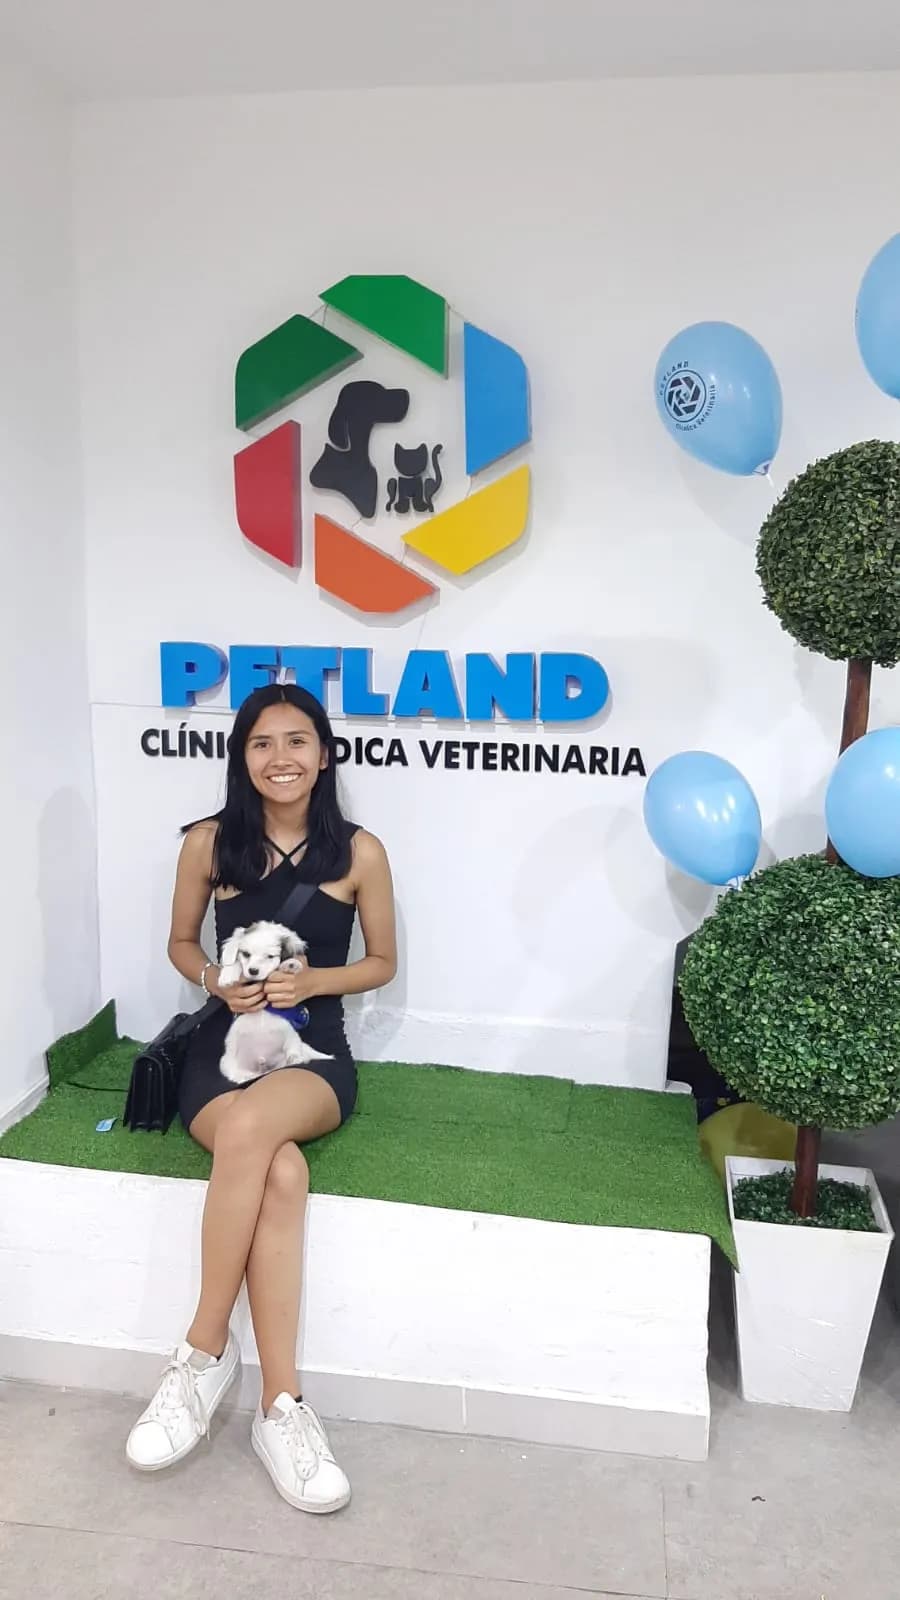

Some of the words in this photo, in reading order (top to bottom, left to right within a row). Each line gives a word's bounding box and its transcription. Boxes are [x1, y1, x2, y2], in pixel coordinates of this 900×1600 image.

[160, 641, 610, 722] PETLAND
[141, 722, 234, 758] CLÍNI
[334, 737, 408, 769] DICA
[419, 740, 646, 776] VETERINARIA
